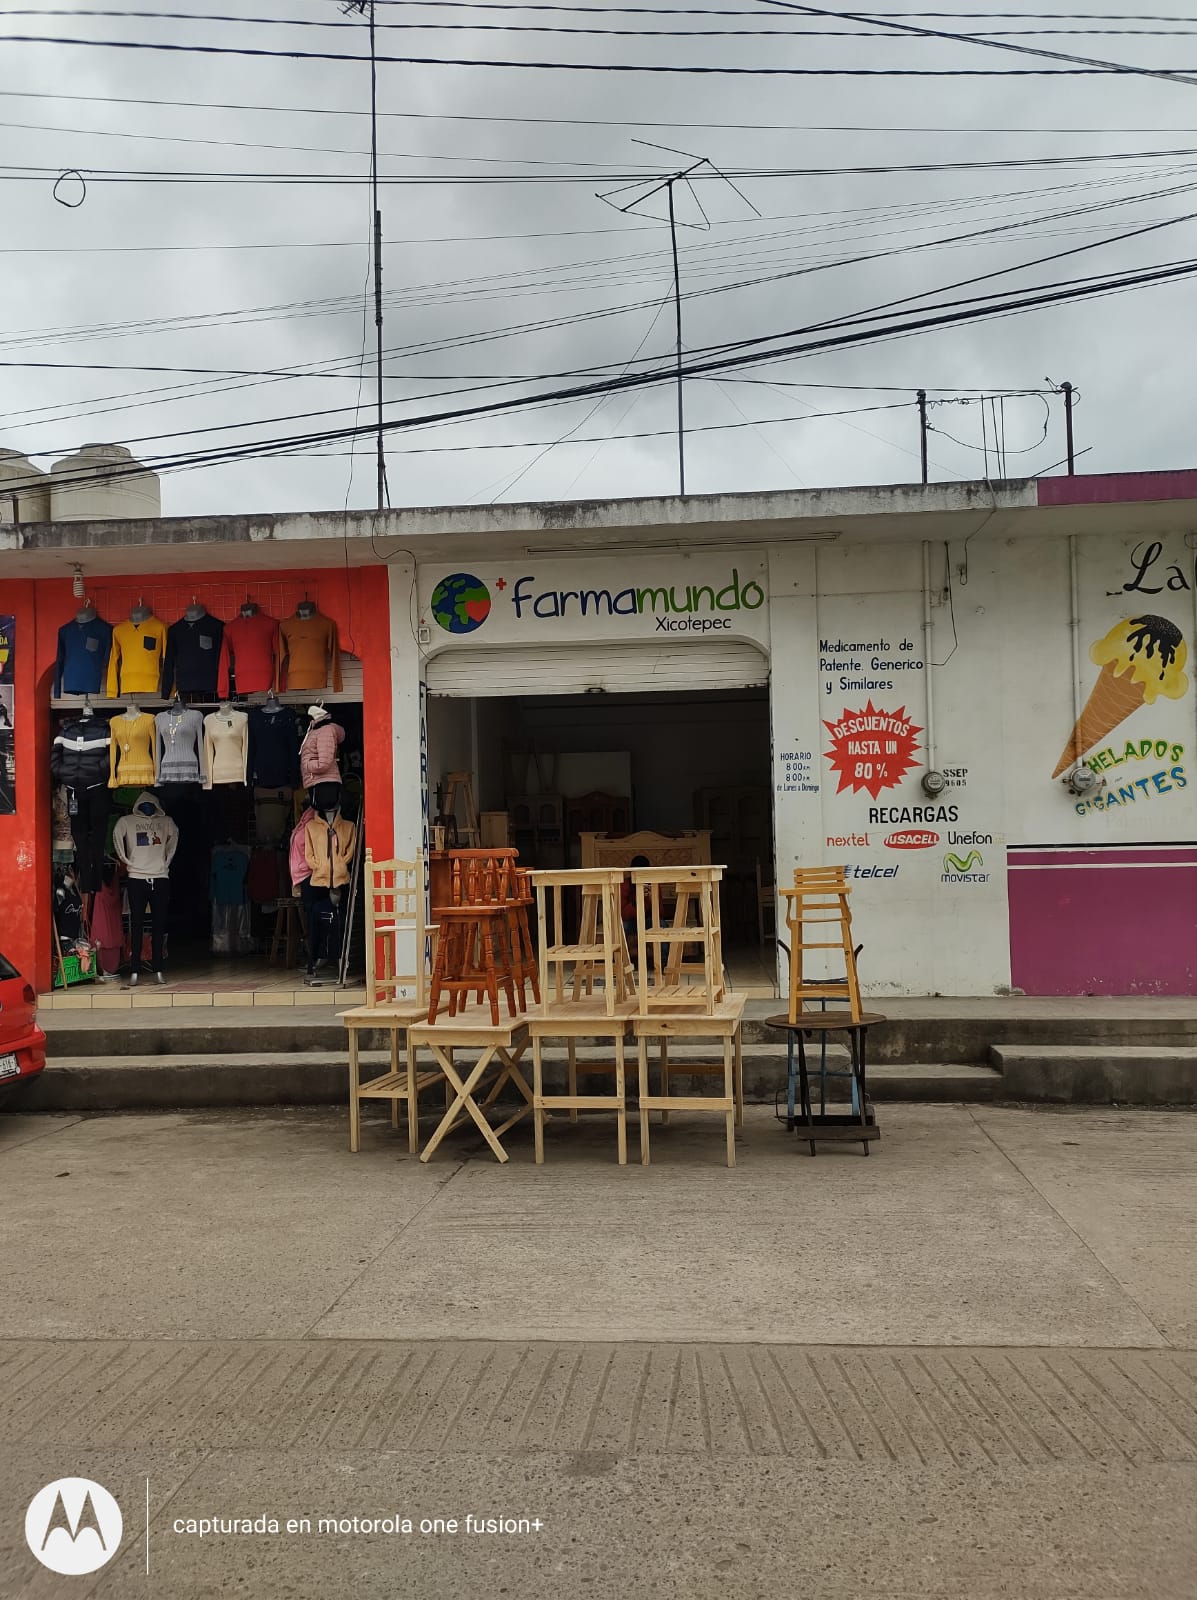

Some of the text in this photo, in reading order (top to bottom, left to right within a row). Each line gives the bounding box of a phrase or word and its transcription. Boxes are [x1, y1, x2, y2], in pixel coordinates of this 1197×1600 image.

[1123, 541, 1191, 594] La
[511, 568, 765, 618] farmamundo
[655, 615, 732, 634] Xicotepec
[819, 638, 914, 653] Medicamento de
[870, 657, 923, 670] Generico
[825, 677, 893, 694] y Similares
[833, 716, 910, 739] DESCUENTOS
[848, 740, 897, 755] HASTA UN
[780, 752, 812, 761] HORARIO
[1087, 740, 1184, 774] HELADOS
[876, 762, 888, 778] %
[1075, 766, 1188, 815] GIGANTES
[869, 806, 959, 824] RECARGAS
[826, 832, 870, 847] nextel
[948, 831, 992, 844] Unefon
[853, 865, 899, 878] telcel
[941, 873, 990, 883] movistar
